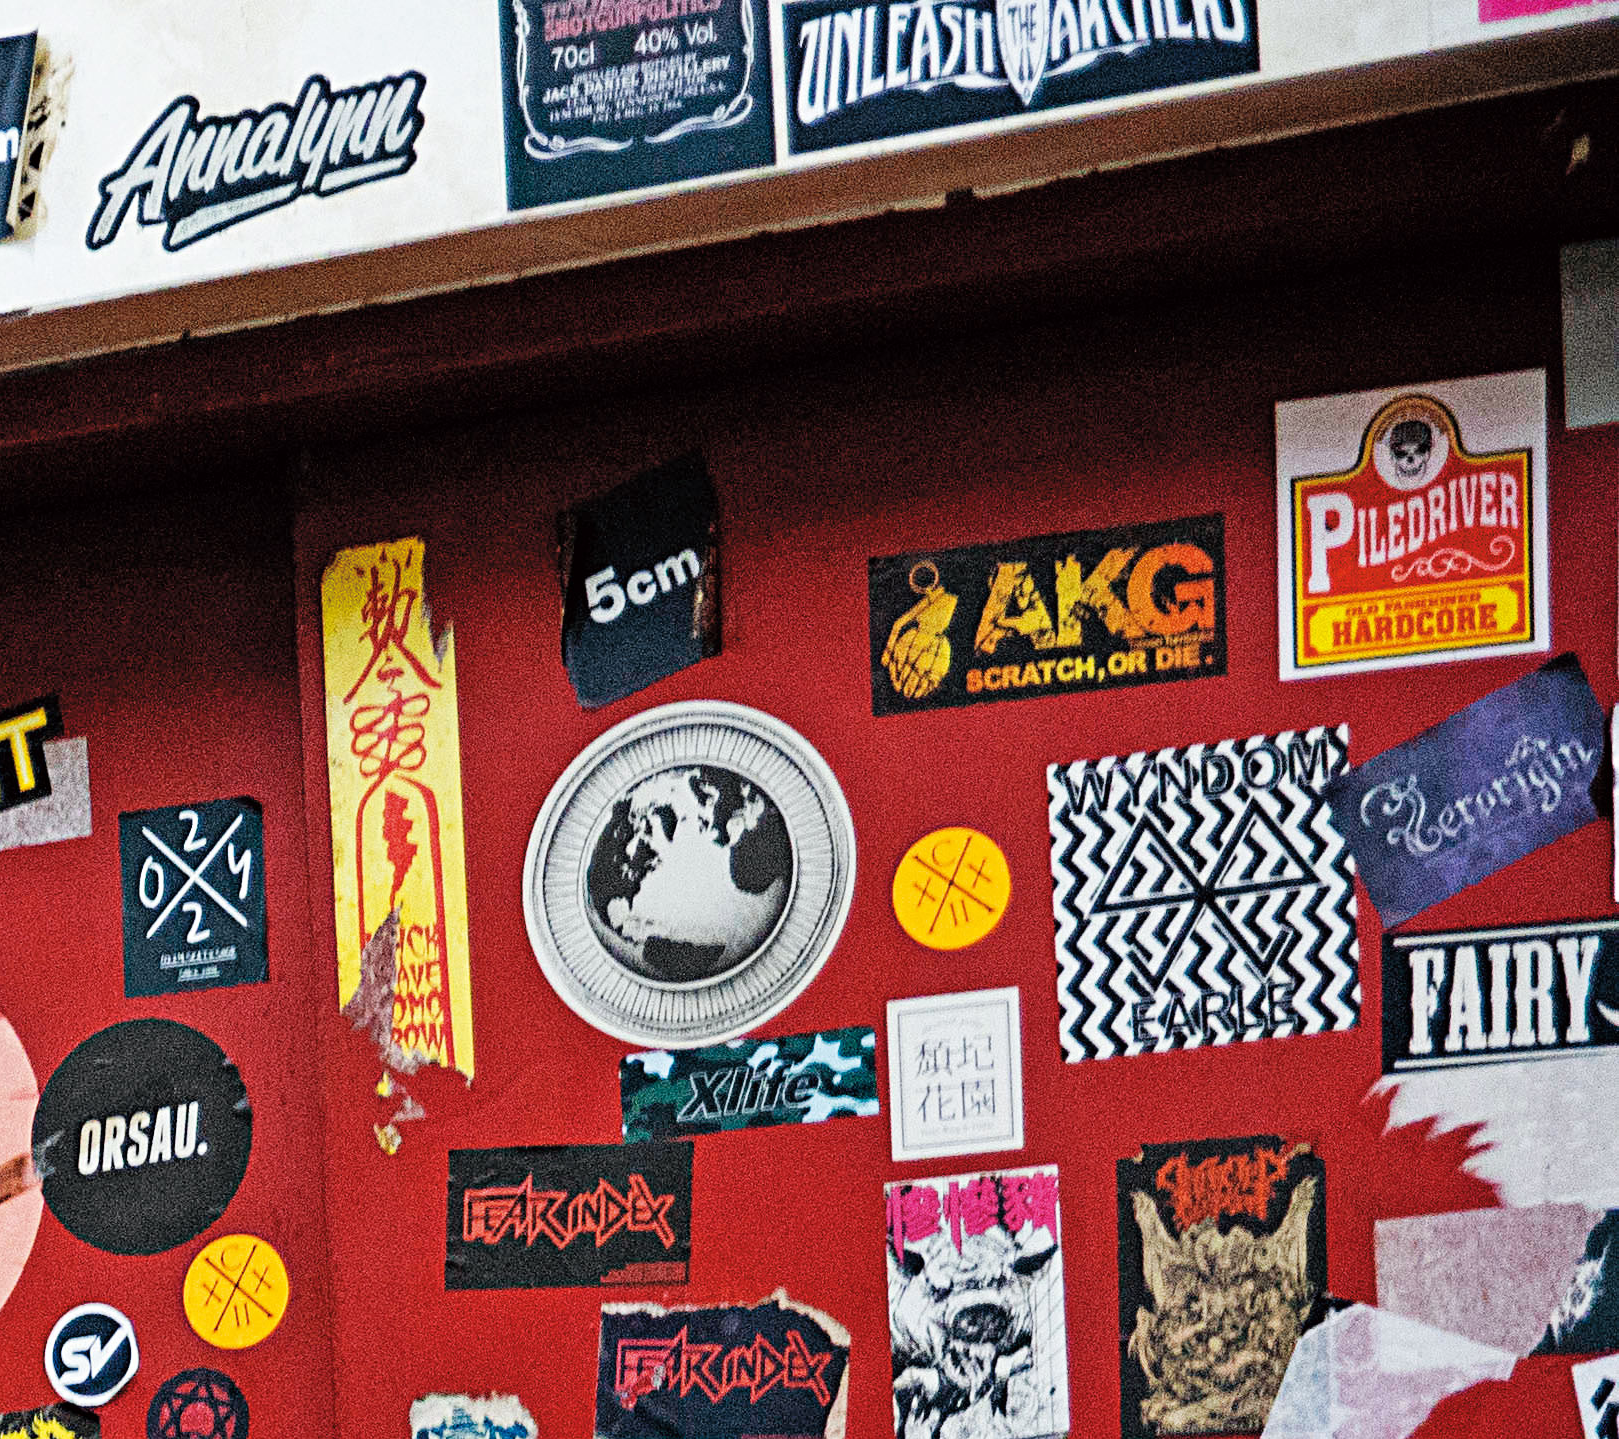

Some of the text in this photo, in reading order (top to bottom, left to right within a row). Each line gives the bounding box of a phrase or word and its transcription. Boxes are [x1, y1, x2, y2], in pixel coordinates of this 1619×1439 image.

[634, 29, 679, 55] 40%
[87, 68, 427, 252] Annalynn
[1307, 472, 1521, 597] PILEDRIVER
[584, 548, 701, 628] 5cm
[974, 542, 1215, 656] AKG
[1332, 603, 1500, 647] HARDCORE
[1064, 737, 1336, 813] WYNDOM
[1131, 978, 1301, 1046] EARLE
[1407, 933, 1598, 1057] FAIRY
[77, 1101, 208, 1174] ORSAU.
